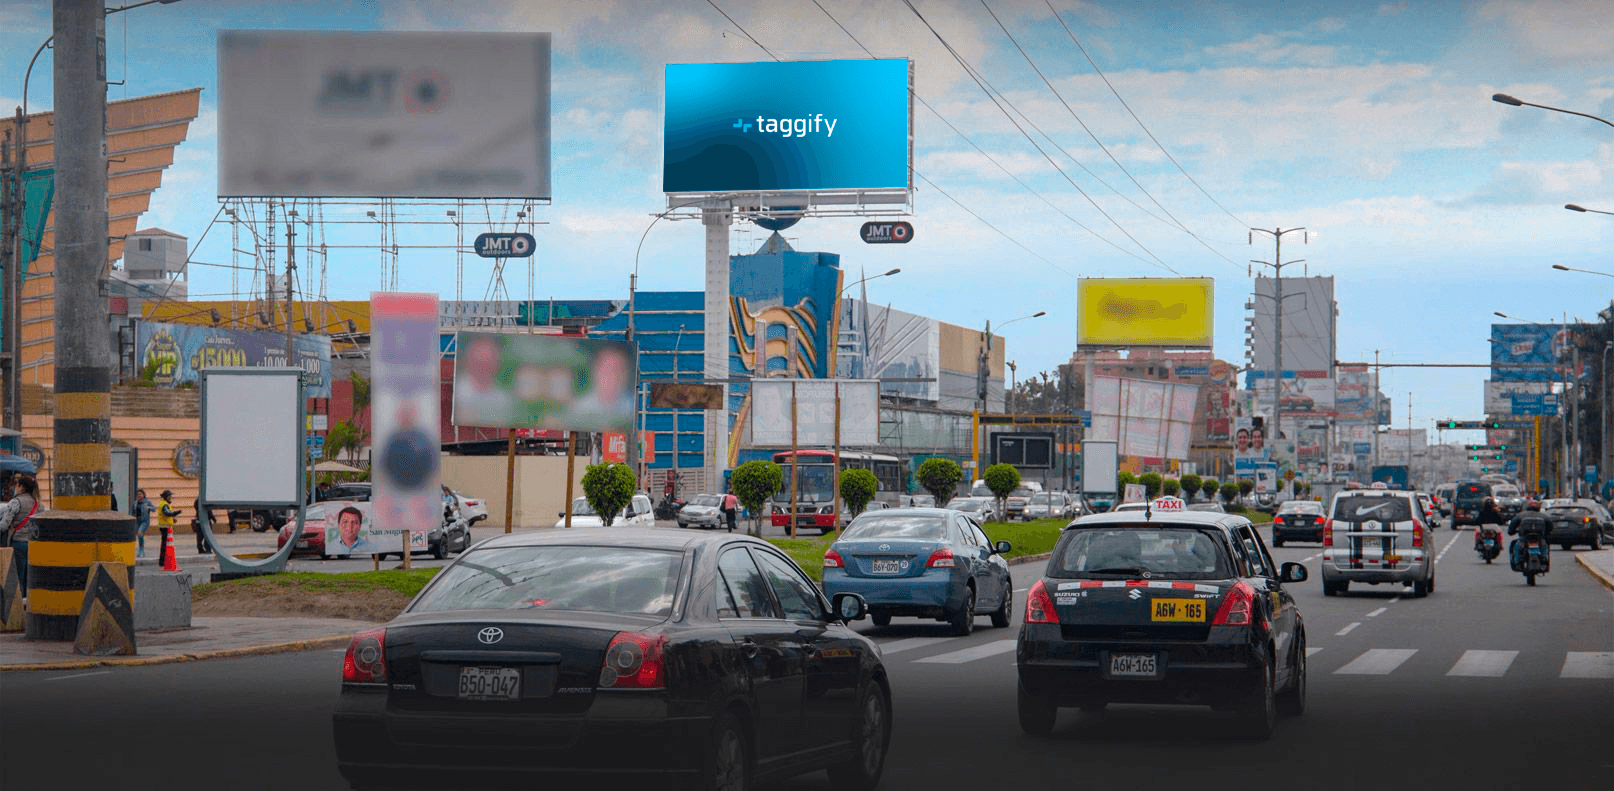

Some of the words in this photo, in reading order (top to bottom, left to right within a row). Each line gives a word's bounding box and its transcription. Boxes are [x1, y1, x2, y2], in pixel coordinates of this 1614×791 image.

[756, 114, 838, 137] taggify
[866, 225, 892, 236] JMT
[482, 237, 511, 250] JMT
[1156, 500, 1183, 509] TAXI
[1155, 603, 1176, 618] A6W
[1185, 603, 1202, 619] 165
[1113, 659, 1155, 673] A6W-165
[460, 675, 518, 695] B50-047
